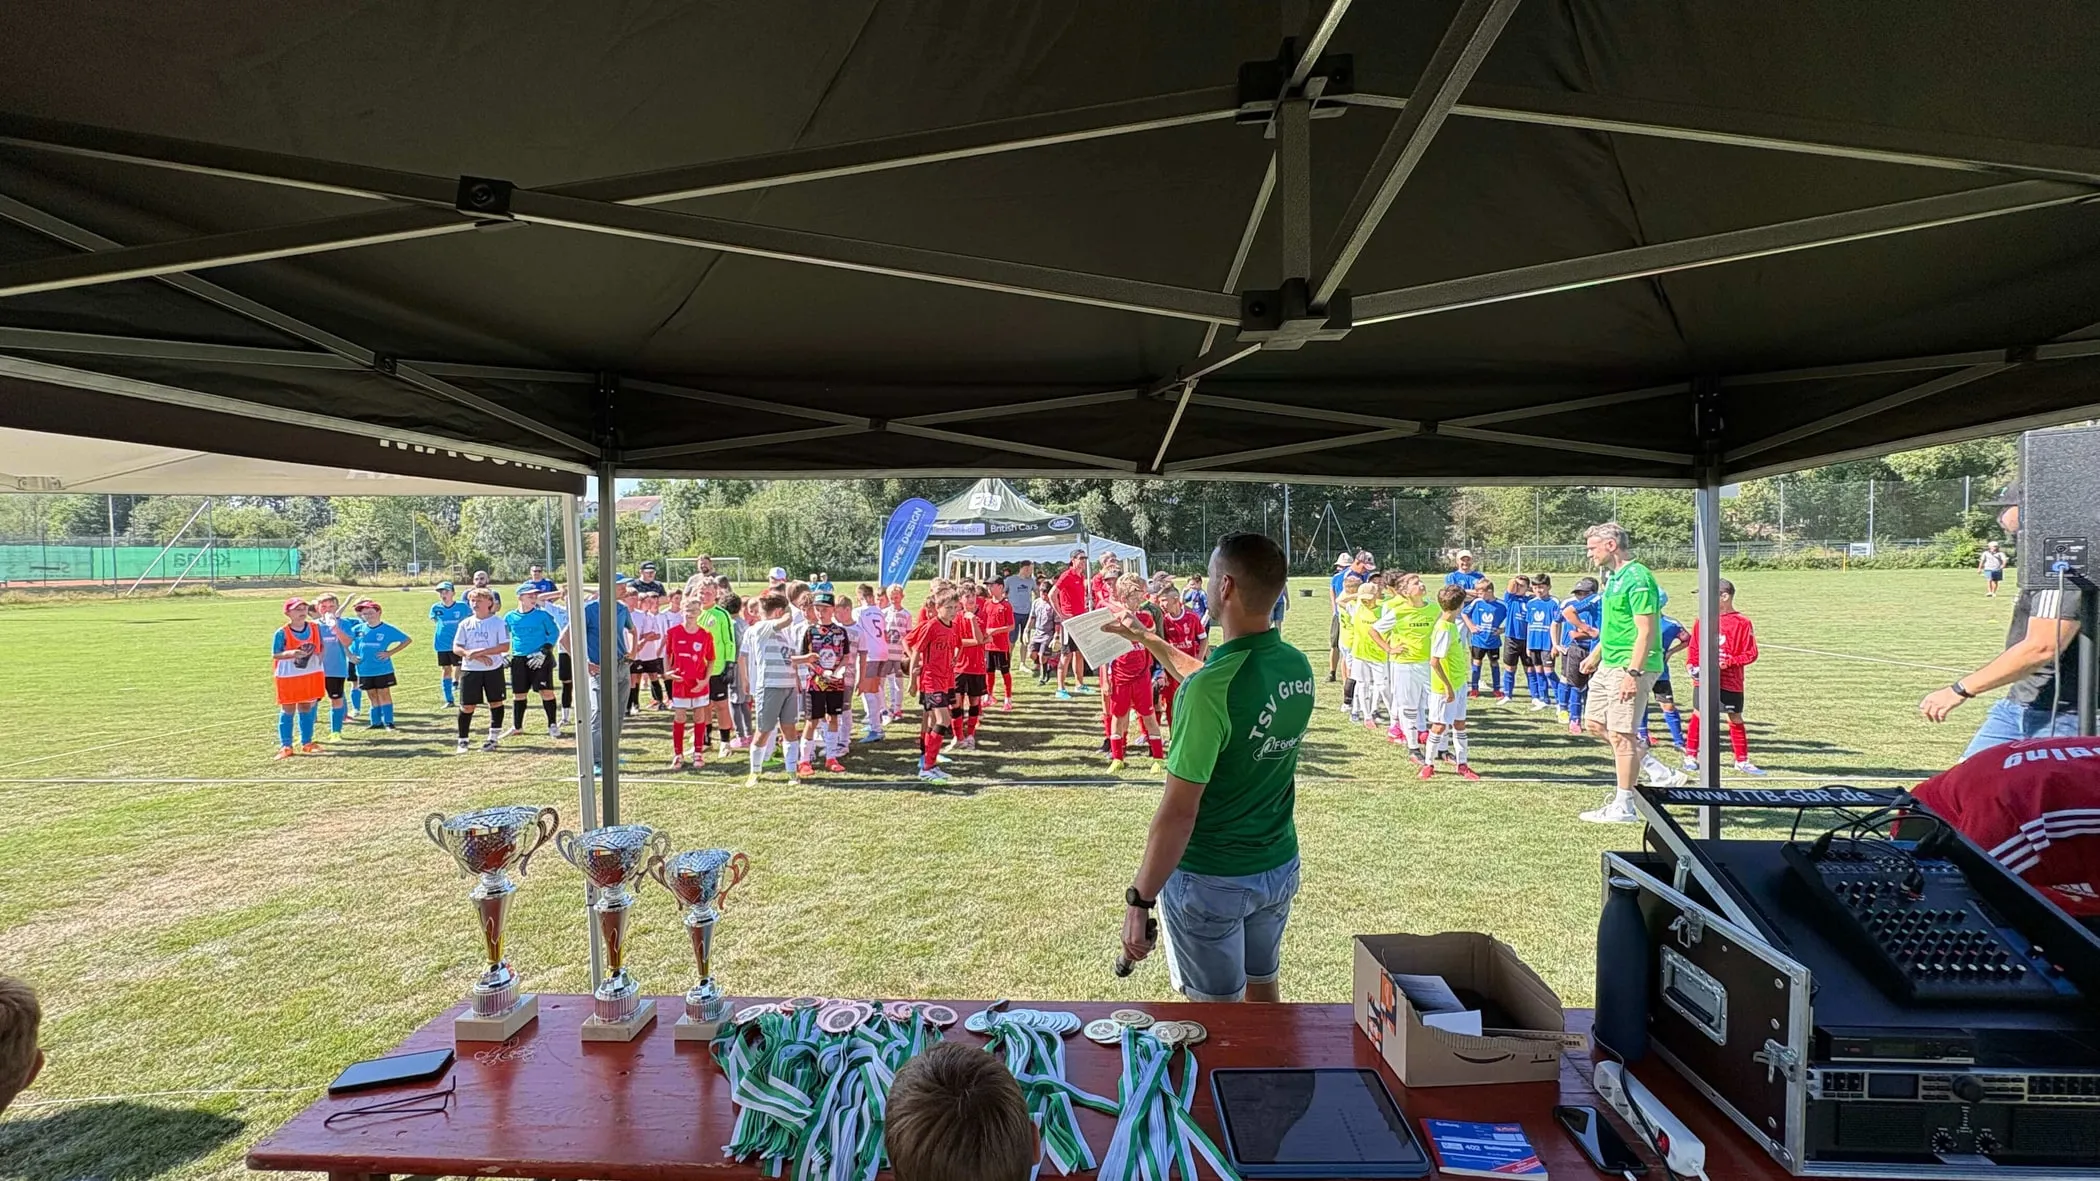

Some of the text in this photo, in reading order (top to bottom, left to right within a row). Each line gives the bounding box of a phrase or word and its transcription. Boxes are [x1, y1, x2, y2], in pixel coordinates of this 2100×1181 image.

[902, 507, 923, 545] DESIGN
[990, 523, 1039, 533] British Cars
[872, 619, 882, 638] 5
[1248, 694, 1277, 740] TSV
[1669, 787, 1874, 803] www.TTB-GbR.de
